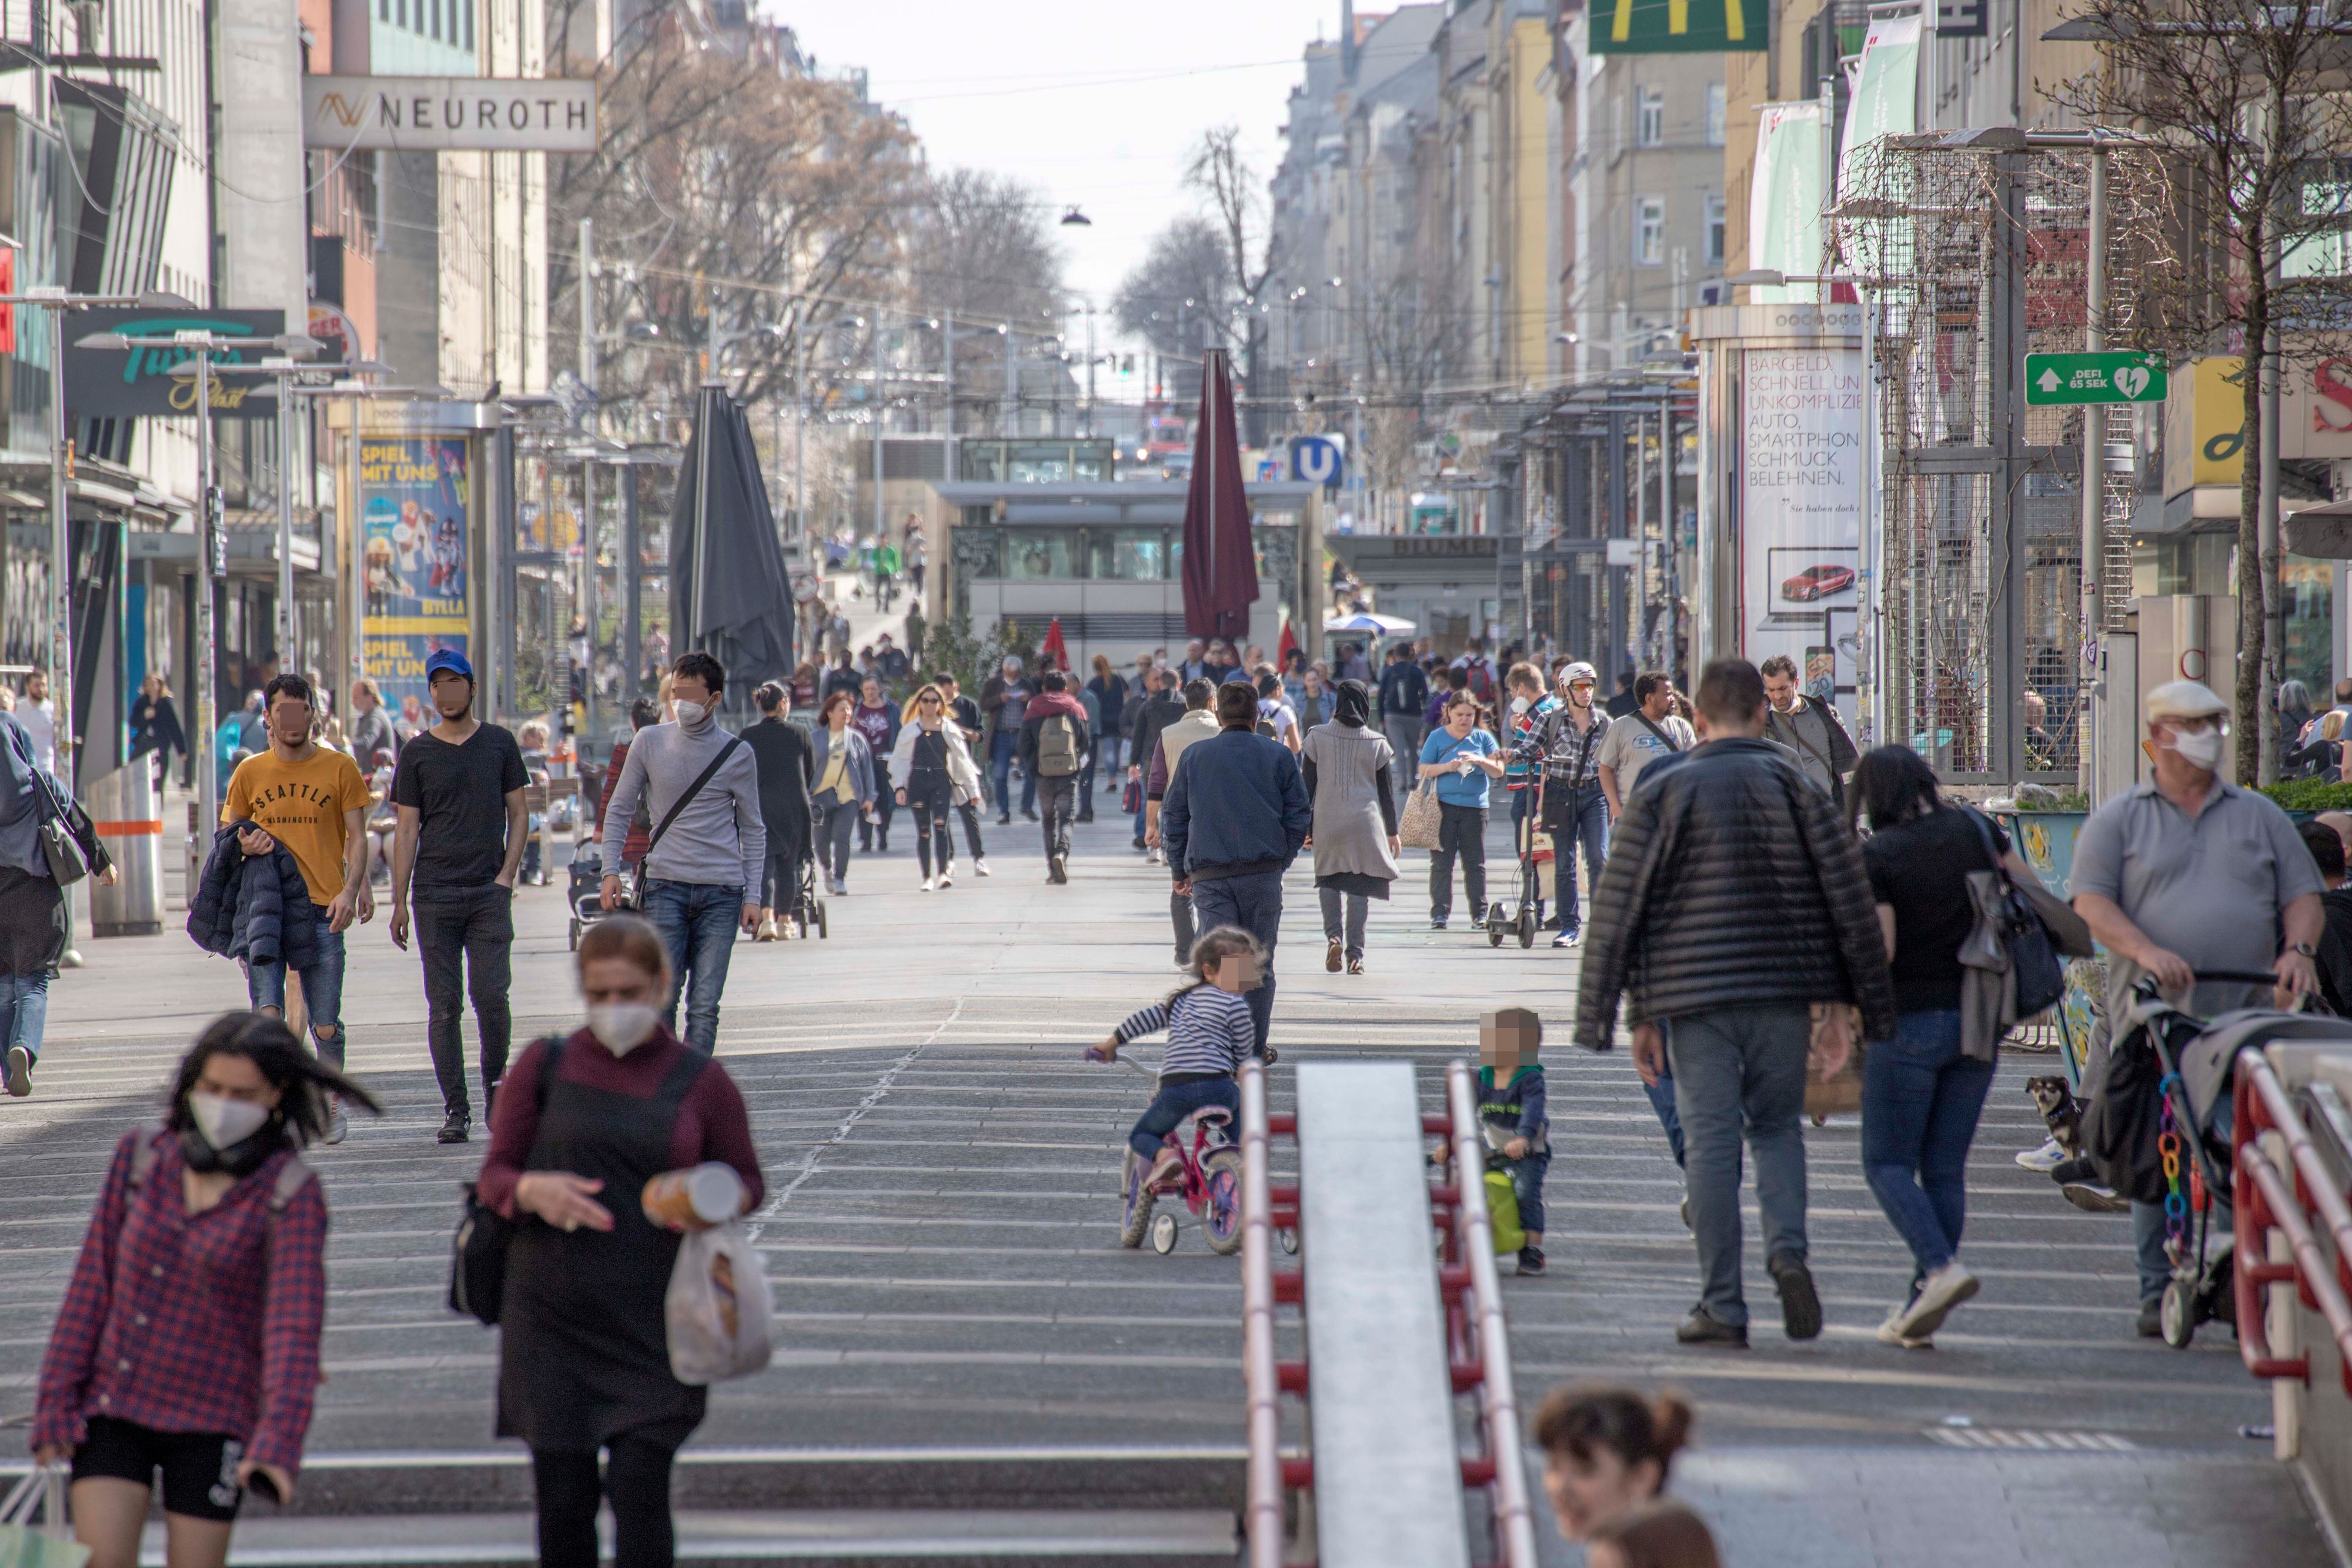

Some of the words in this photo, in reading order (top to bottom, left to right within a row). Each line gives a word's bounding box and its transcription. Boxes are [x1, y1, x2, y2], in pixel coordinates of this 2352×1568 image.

[379, 97, 587, 131] NEUROTH
[308, 316, 342, 336] GER
[292, 371, 332, 385] NIS
[2076, 369, 2102, 378] DEFI
[1750, 376, 1828, 392] SCHNELL
[1834, 375, 1859, 391] UN
[2070, 379, 2083, 389] 65
[2086, 379, 2108, 388] SEK
[1749, 414, 1801, 430] AUTO,
[1749, 432, 1859, 448] SMARTPHON
[1299, 445, 1334, 482] U
[1749, 452, 1838, 467] SCHMUCK
[361, 465, 393, 482] MIT
[395, 465, 438, 482] UNS
[1749, 470, 1845, 487] BELEHNEN.
[1806, 504, 1832, 513] haben
[1835, 504, 1855, 513] doch
[422, 599, 465, 615] BILLA
[363, 660, 395, 677] MIT
[396, 659, 426, 677] UN
[255, 783, 332, 809] SEATTLE
